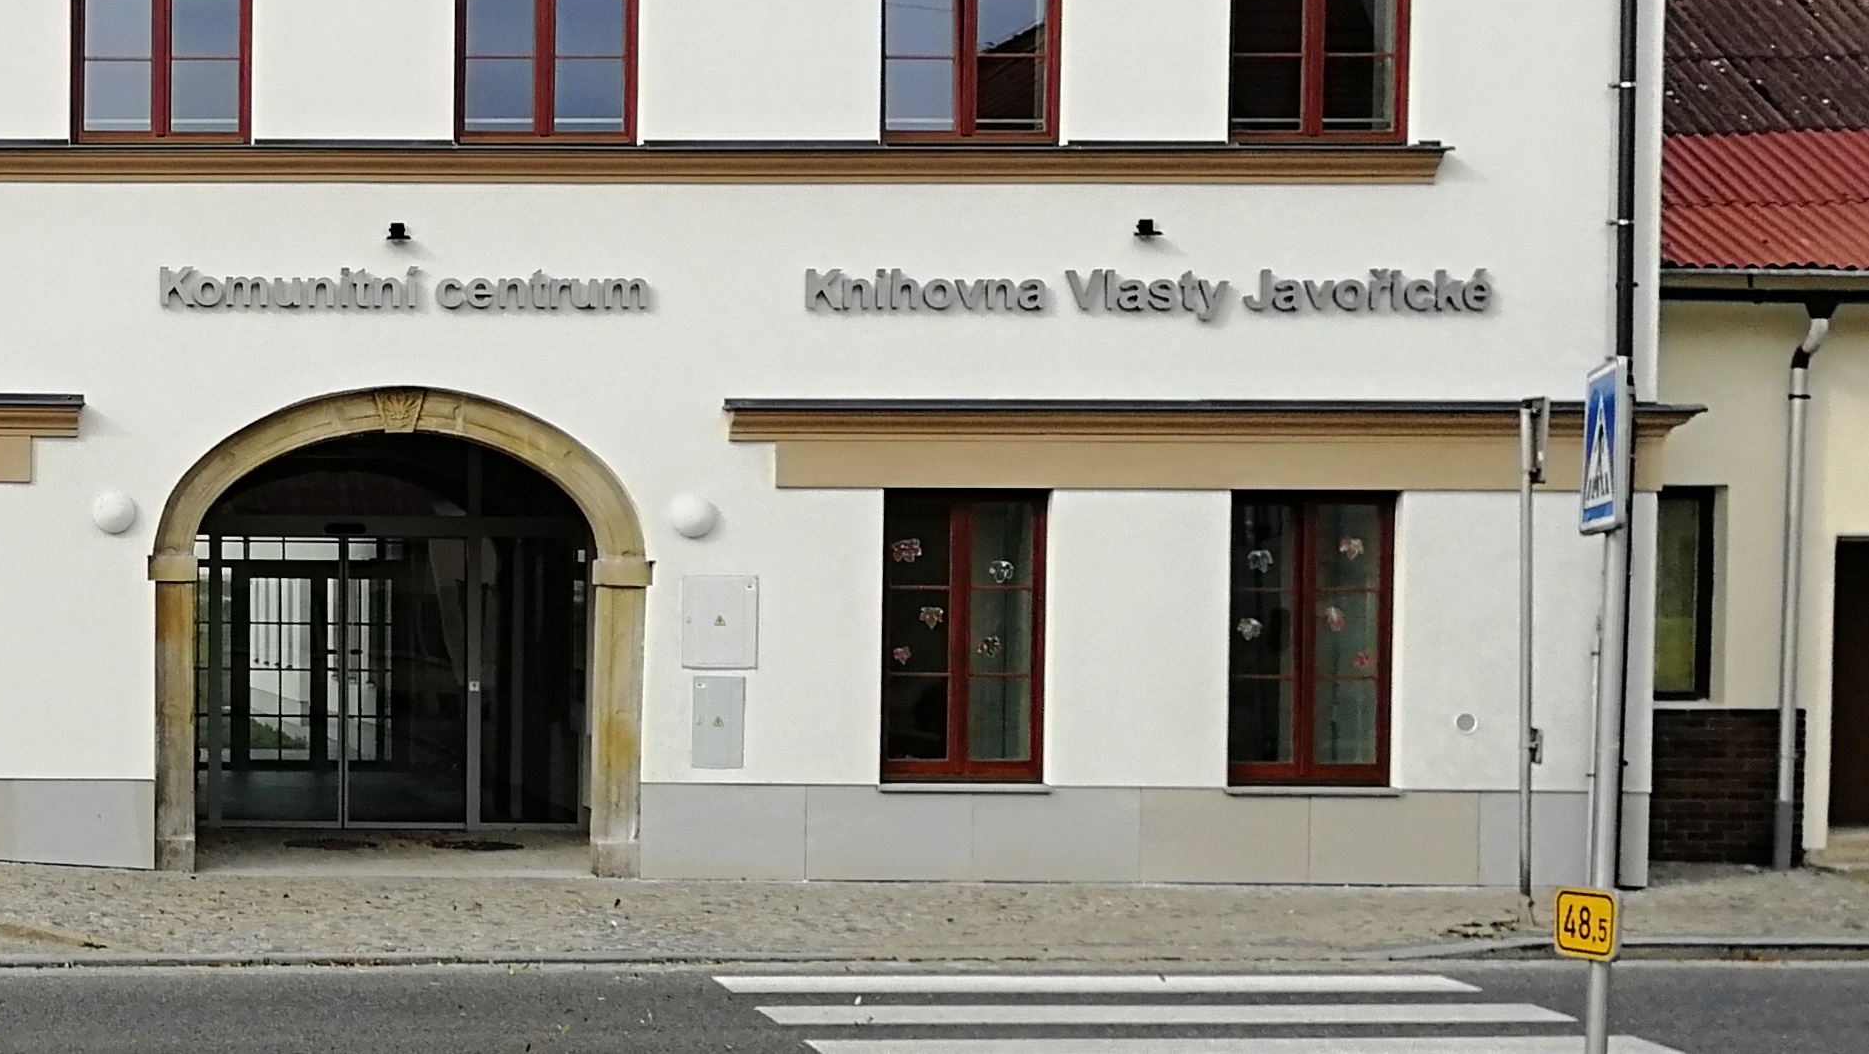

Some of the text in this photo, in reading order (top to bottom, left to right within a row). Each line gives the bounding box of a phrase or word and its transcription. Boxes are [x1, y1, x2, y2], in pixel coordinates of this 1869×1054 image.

[159, 266, 649, 310] Komunitní centrum
[805, 267, 1494, 322] Knihovna Vlasty Javořické
